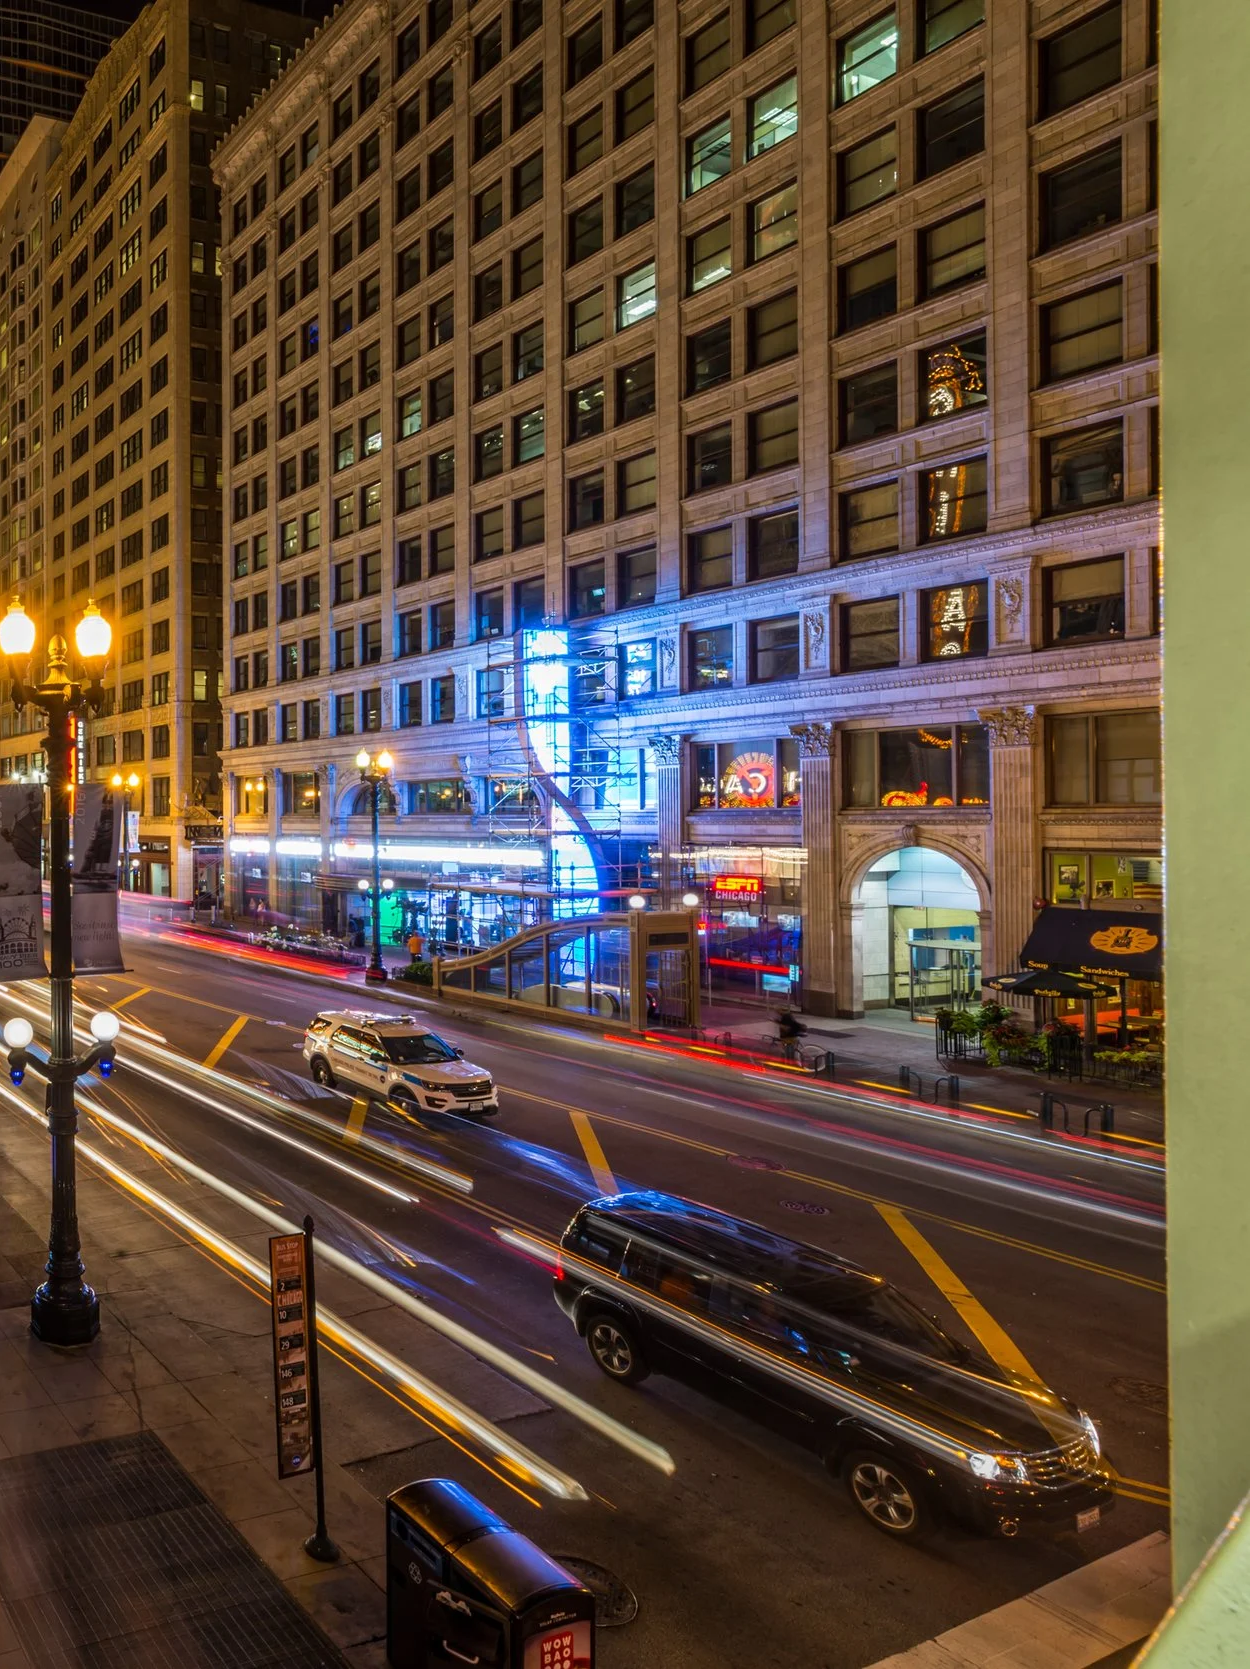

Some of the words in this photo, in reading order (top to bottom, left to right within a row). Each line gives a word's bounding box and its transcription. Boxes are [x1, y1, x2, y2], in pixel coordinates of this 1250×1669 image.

[716, 877, 759, 891] ESPN
[715, 890, 757, 902] CHICAGO
[1028, 960, 1049, 971] Soup
[1080, 966, 1130, 978] Sandwiches
[280, 1282, 285, 1291] 2
[279, 1310, 287, 1320] 10
[281, 1341, 290, 1350] 29
[281, 1368, 293, 1378] 146
[282, 1397, 294, 1407] 148
[542, 1635, 572, 1653] WOW
[544, 1647, 571, 1664] BAO
